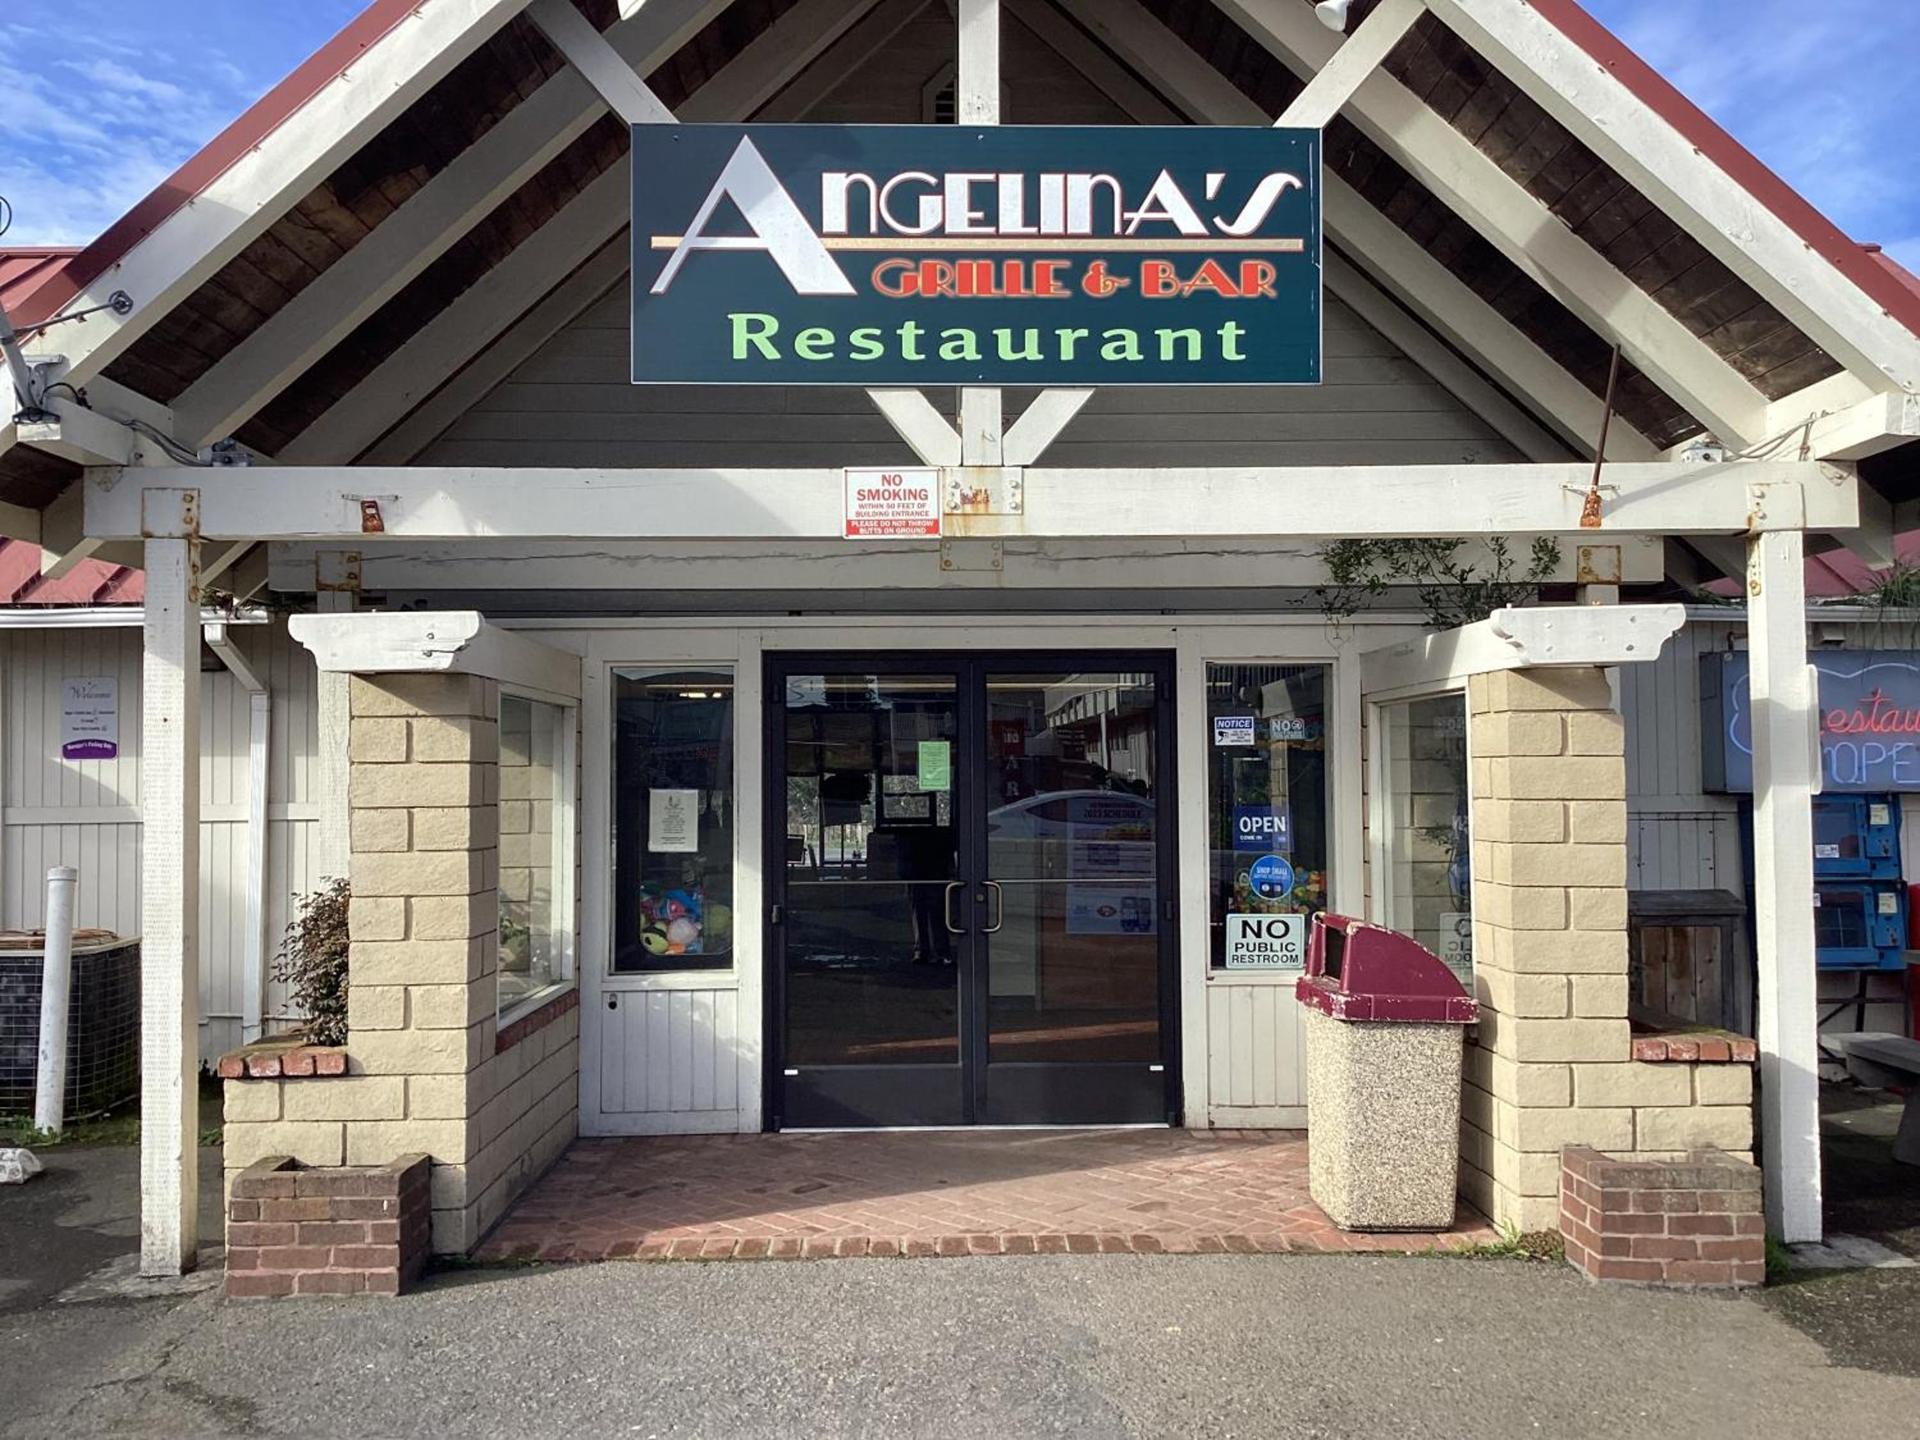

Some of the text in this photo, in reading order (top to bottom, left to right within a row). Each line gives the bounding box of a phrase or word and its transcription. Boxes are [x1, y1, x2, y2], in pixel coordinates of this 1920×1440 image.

[872, 259, 1278, 298] GRILLE & BAR
[728, 312, 1247, 362] Restaurant
[881, 474, 903, 487] NO
[857, 489, 929, 501] SMOKING
[858, 502, 884, 510] WITHIN
[855, 510, 889, 518] BUILDING
[851, 520, 878, 528] PLEASE
[880, 520, 891, 528] DO
[1820, 688, 1920, 735] estau
[1217, 720, 1251, 728] NOTICE
[1824, 741, 1920, 783] OPE
[1239, 816, 1286, 832] OPEN
[1241, 919, 1290, 939] NO
[1234, 942, 1296, 953] PUBLIC
[1231, 954, 1299, 964] RESTROOM
